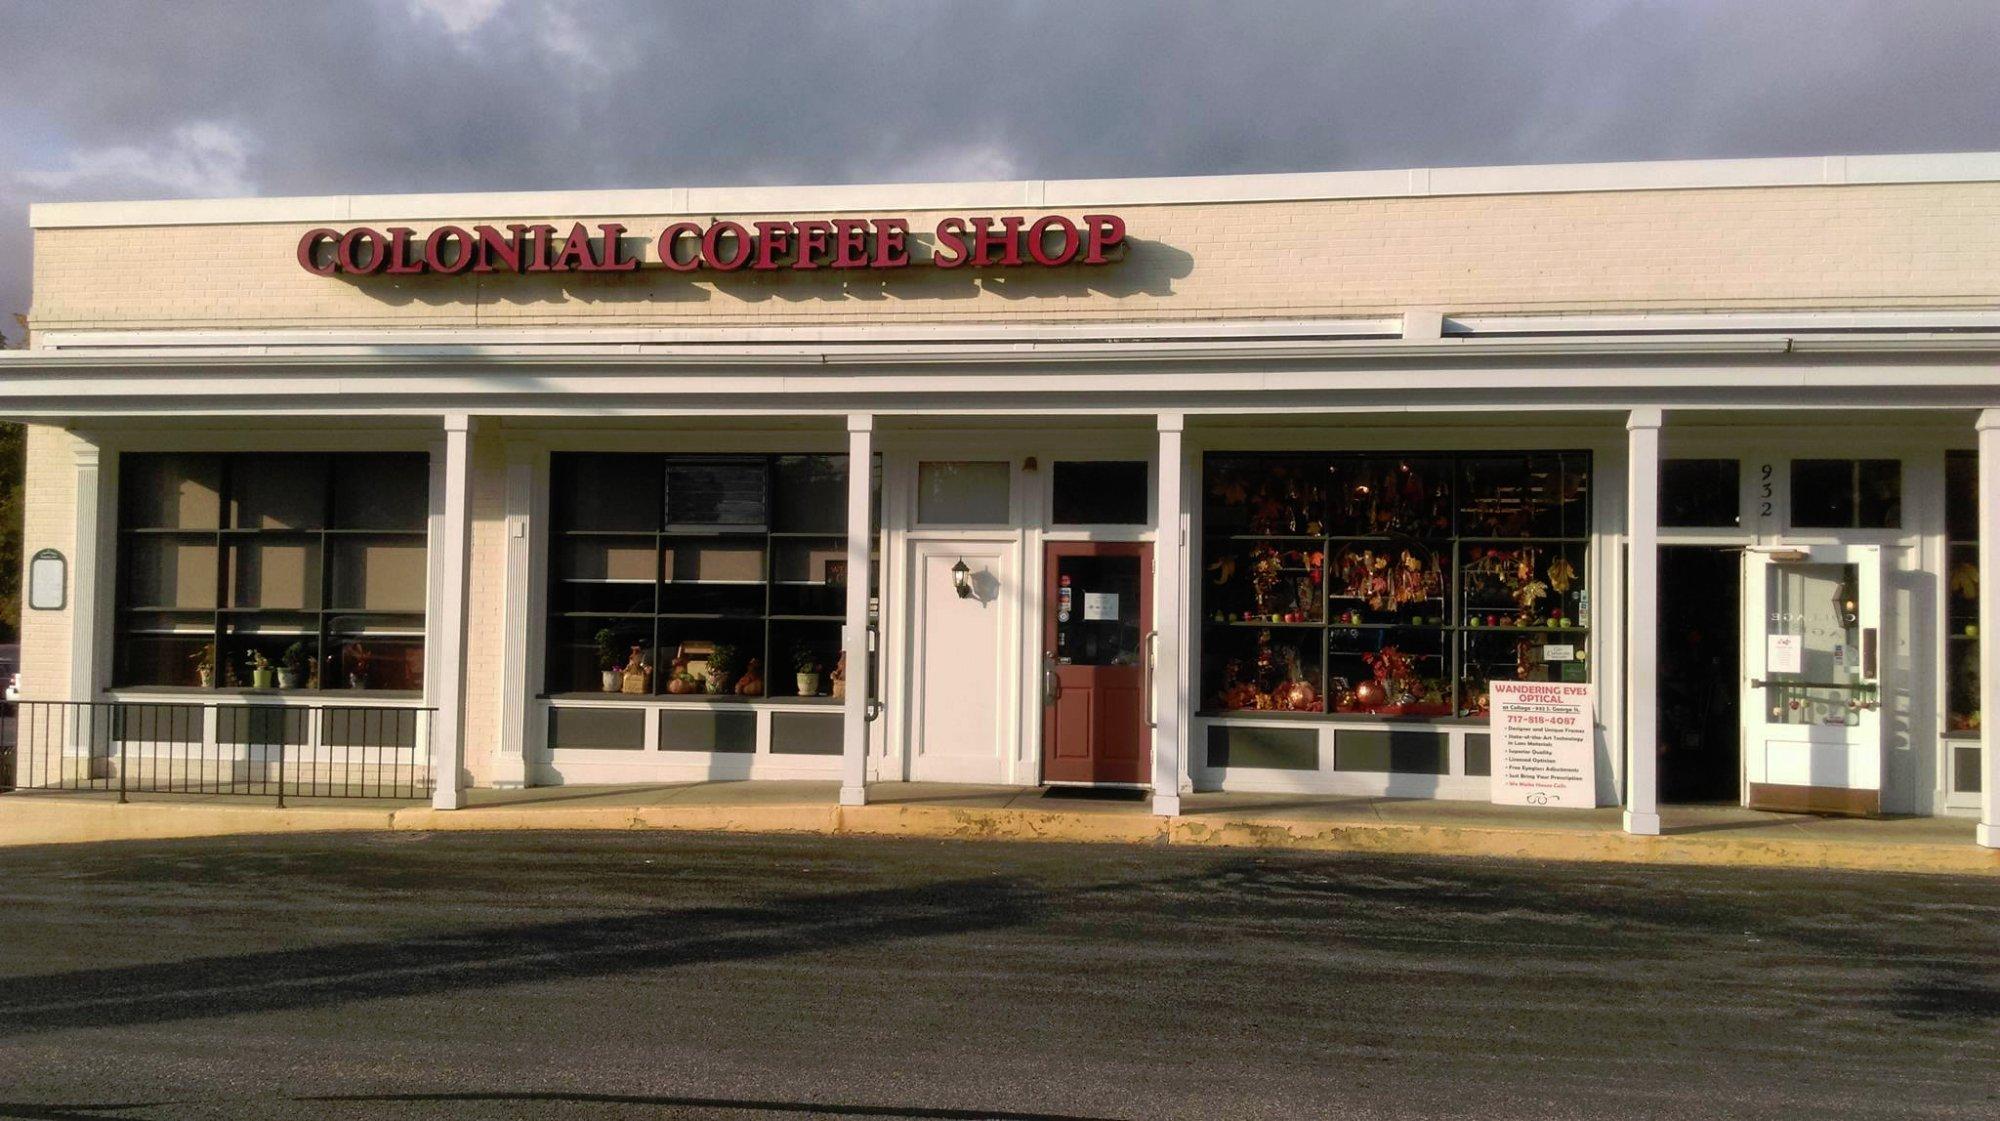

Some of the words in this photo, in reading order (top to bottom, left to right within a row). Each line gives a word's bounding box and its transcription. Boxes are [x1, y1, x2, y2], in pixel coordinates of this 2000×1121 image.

[297, 222, 640, 276] COLONIAL
[658, 217, 910, 273] COFFEE
[933, 214, 1127, 268] SHOP
[1761, 464, 1772, 517] 932
[1495, 684, 1561, 695] WANDERING
[1563, 686, 1587, 696] EYES
[1519, 694, 1564, 703] OPTICAL
